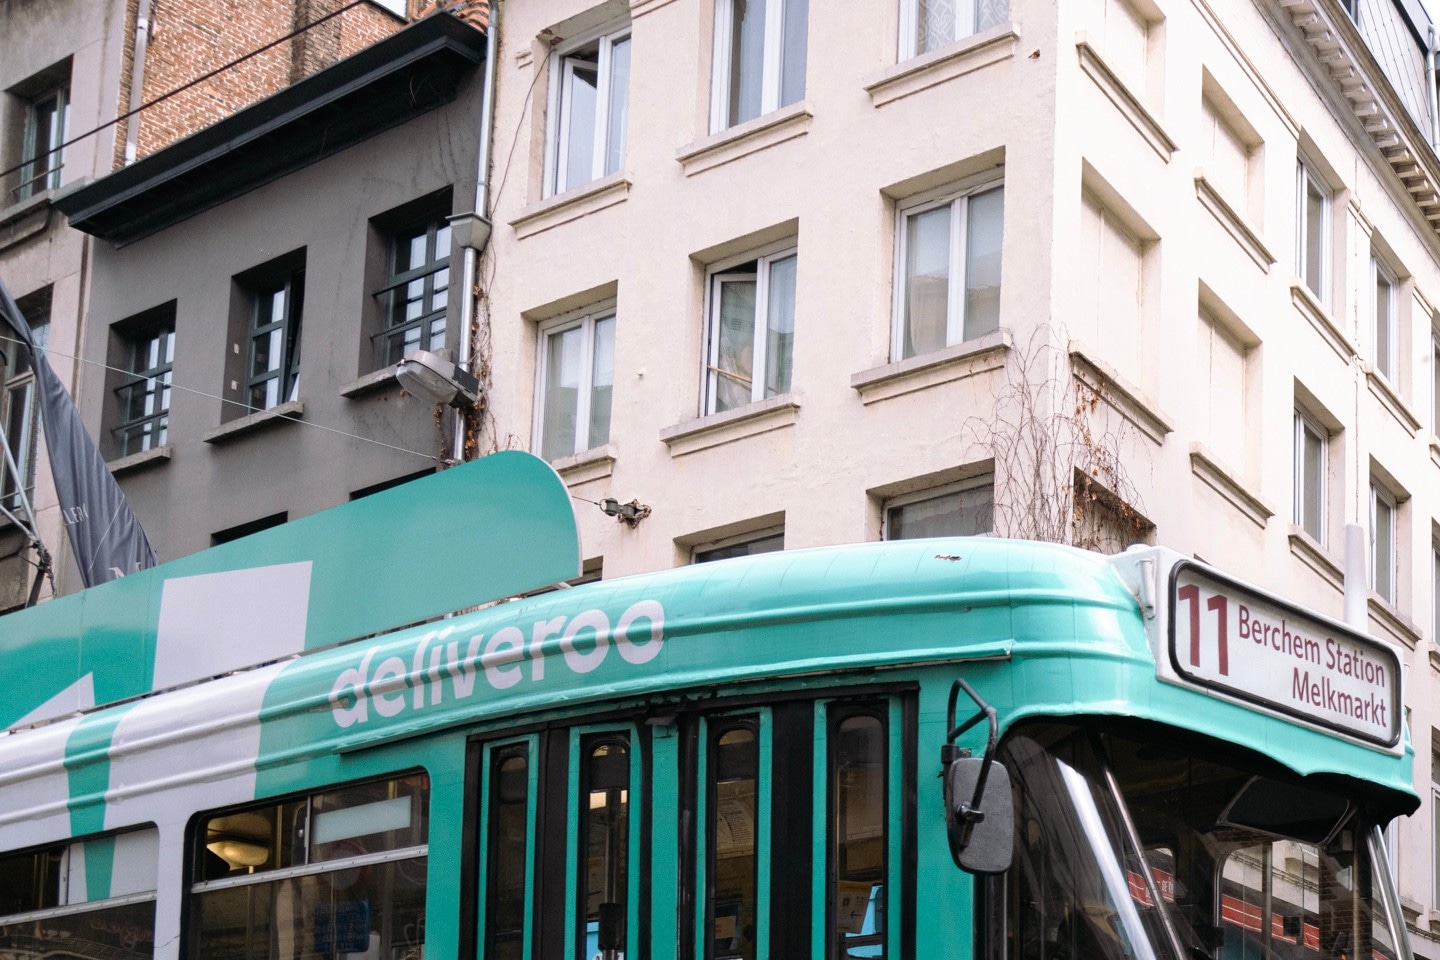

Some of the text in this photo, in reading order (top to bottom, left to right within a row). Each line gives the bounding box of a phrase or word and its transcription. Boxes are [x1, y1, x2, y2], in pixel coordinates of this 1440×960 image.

[328, 599, 666, 728] deliveroo
[1178, 584, 1229, 677] 11
[1238, 604, 1385, 688] Berchem Station
[1292, 667, 1387, 728] Melkmarkt
